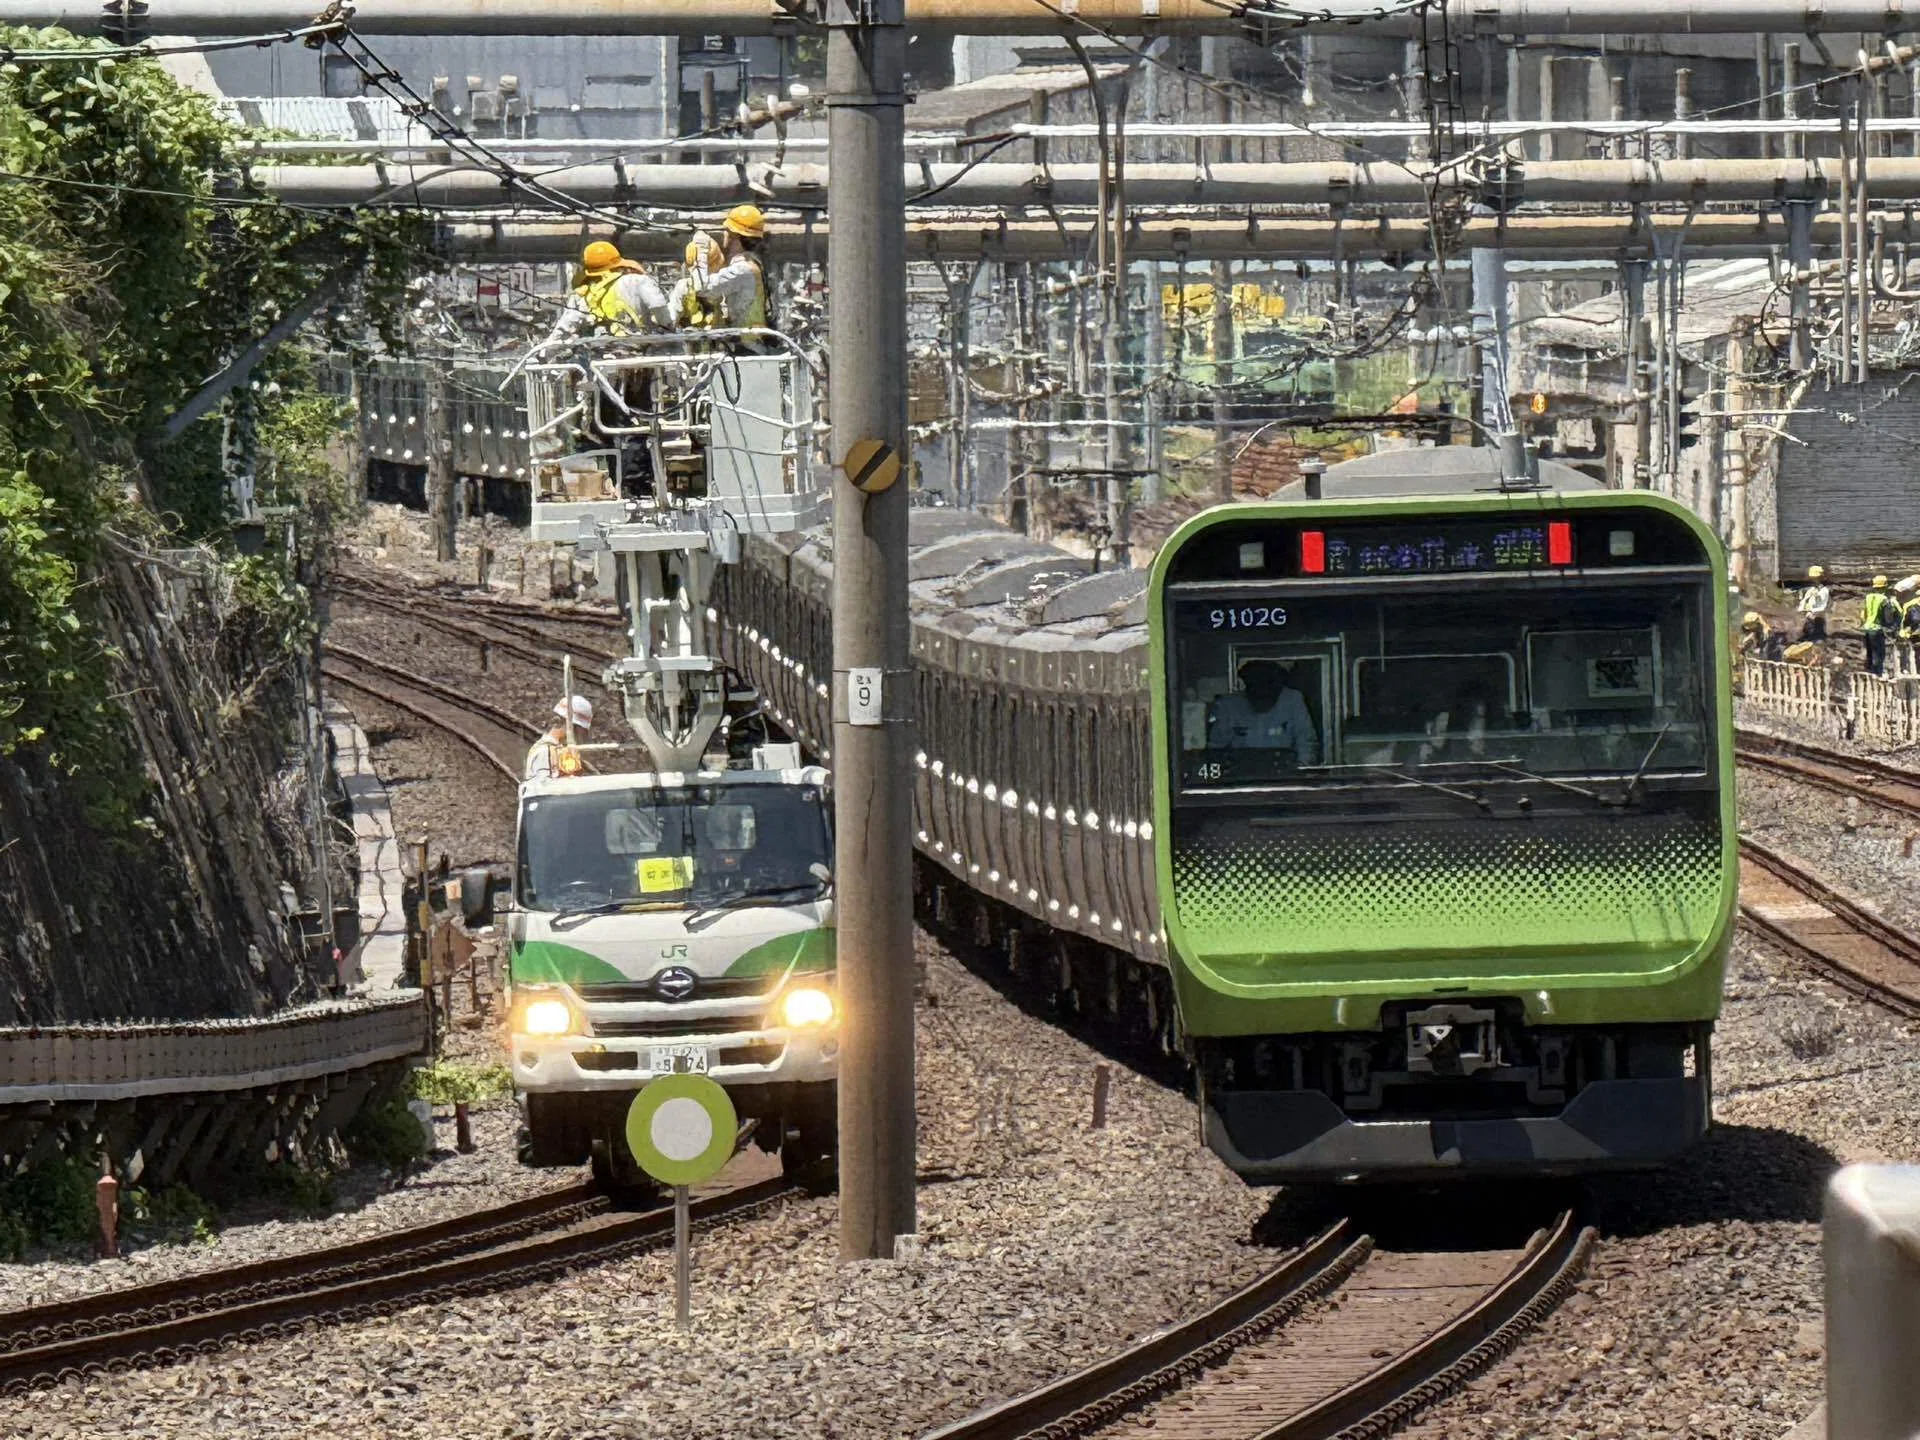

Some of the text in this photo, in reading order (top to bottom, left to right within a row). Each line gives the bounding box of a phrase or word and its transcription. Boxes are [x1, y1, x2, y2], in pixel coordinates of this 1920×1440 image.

[1210, 607, 1287, 628] 9102G
[859, 687, 871, 707] 9
[1198, 763, 1221, 780] 48
[661, 944, 688, 959] JR
